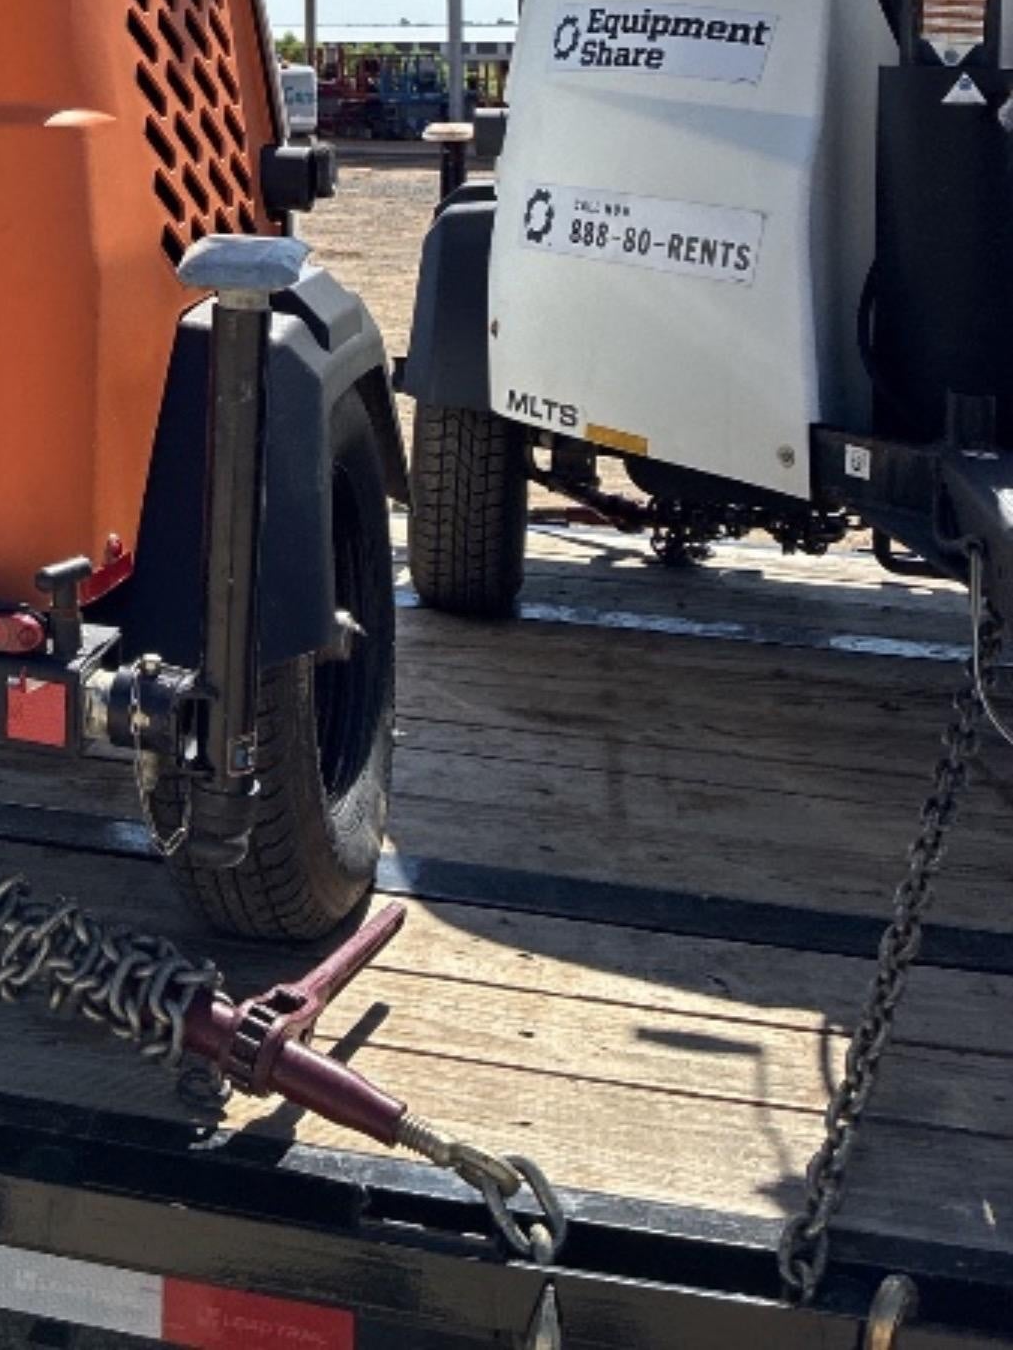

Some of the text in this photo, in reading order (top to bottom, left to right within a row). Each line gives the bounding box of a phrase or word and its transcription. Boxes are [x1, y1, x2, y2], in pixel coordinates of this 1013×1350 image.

[587, 8, 771, 46] Equipment
[580, 39, 665, 70] Share
[568, 218, 752, 271] 888-80-RENTS
[506, 390, 579, 429] MLTS
